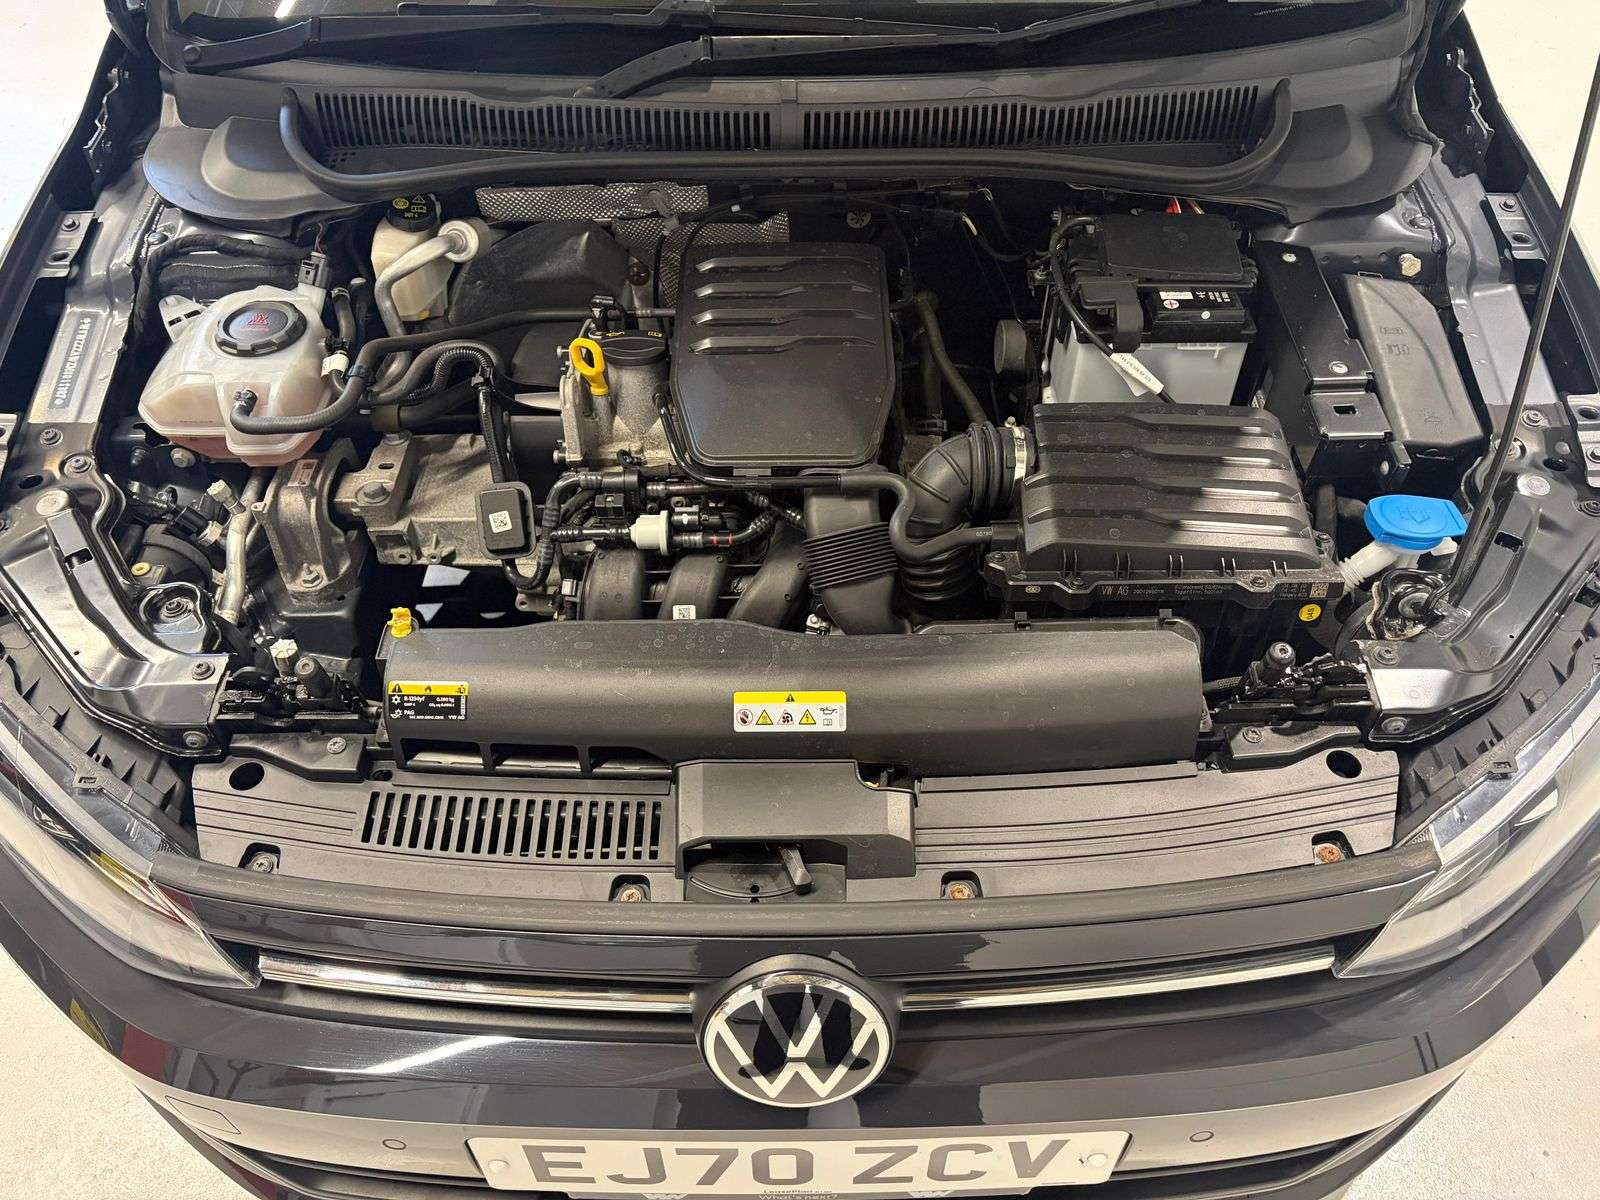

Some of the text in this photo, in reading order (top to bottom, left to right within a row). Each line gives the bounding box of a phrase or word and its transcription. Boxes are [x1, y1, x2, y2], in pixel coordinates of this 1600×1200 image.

[1117, 585, 1129, 596] AG
[521, 1138, 1072, 1186] EJ70 ZCV
